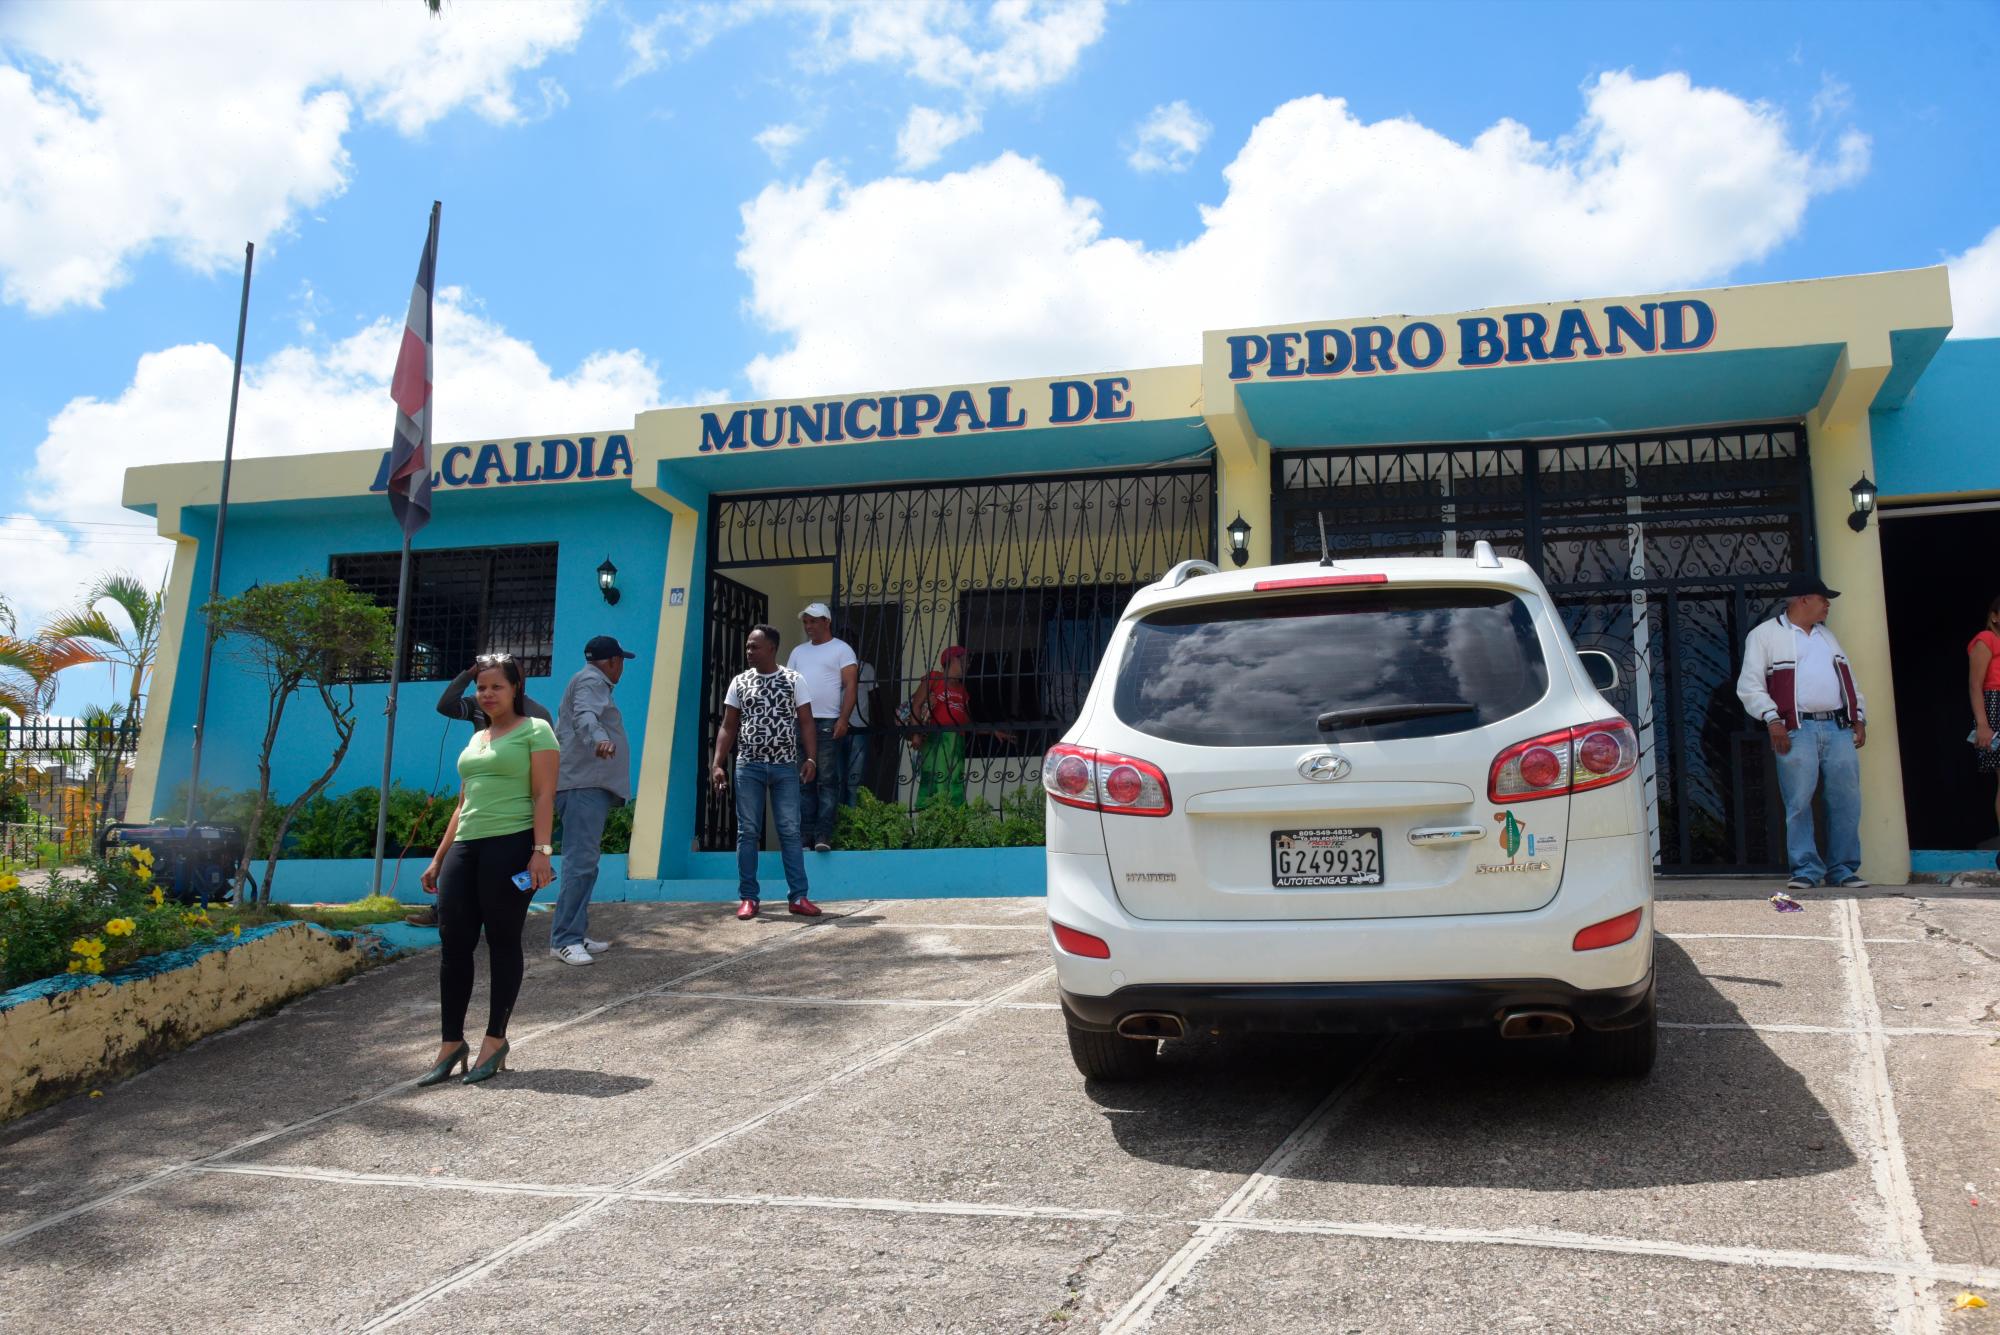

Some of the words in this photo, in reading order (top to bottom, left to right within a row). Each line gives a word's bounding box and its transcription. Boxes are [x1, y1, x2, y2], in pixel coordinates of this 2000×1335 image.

[369, 434, 633, 493] CALDIA
[699, 387, 1027, 453] MUNICIPAL
[1049, 377, 1134, 424] DE
[1227, 321, 1447, 381] PEDRO
[1457, 299, 1717, 368] BRAND
[671, 592, 683, 604] 02
[1280, 849, 1377, 874] G249932
[1277, 876, 1348, 887] AUTOTECNIGAS
